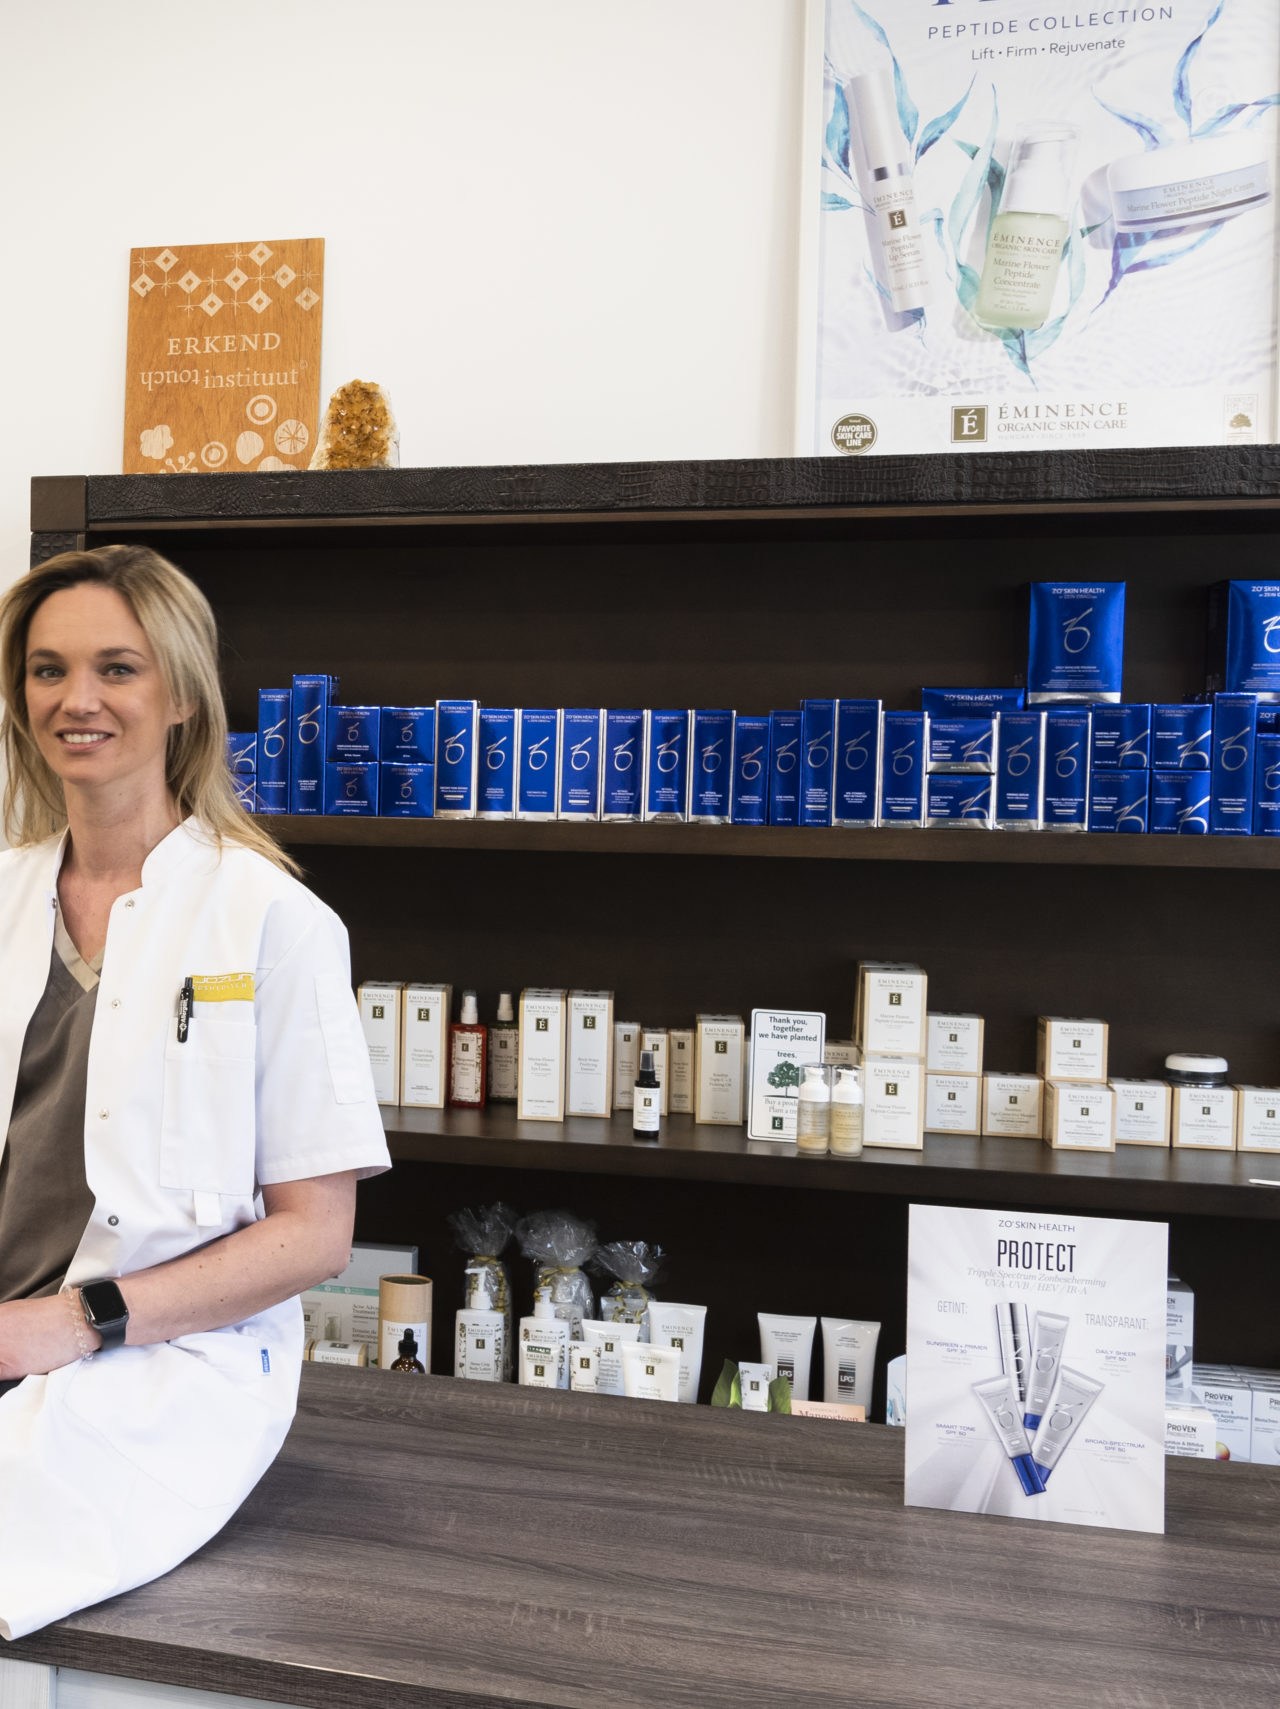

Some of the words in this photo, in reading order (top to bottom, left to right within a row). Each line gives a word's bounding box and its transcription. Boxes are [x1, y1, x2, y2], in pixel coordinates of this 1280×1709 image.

[928, 20, 1018, 39] PEPTIDE
[1028, 6, 1173, 31] COLLECTION
[971, 48, 995, 61] Lift
[1006, 45, 1037, 58] Firm
[1049, 38, 1126, 57] Rejuvenate
[167, 332, 281, 356] ERKEND
[140, 369, 200, 392] touch
[203, 367, 299, 389] instituut
[997, 402, 1128, 420] ÉMINENCE
[837, 424, 871, 433] FAVORITE
[961, 408, 979, 435] É
[997, 421, 1057, 432] ORGANIC
[1060, 420, 1090, 431] SKIN
[1094, 419, 1128, 430] CARE
[836, 432, 853, 440] SKIN
[854, 431, 873, 439] CARE
[846, 439, 862, 447] LINE
[769, 1016, 790, 1024] Thank
[792, 1018, 808, 1026] you,
[773, 1025, 803, 1033] together
[771, 1032, 788, 1040] have
[790, 1034, 817, 1042] planted
[1015, 1221, 1037, 1230] SKIN
[1038, 1223, 1076, 1232] HEALTH
[997, 1239, 1077, 1273] PROTECT
[967, 1267, 998, 1278] Tripple
[998, 1270, 1037, 1281] Spectrum
[1038, 1273, 1107, 1288] Zonbescherming
[984, 1279, 1030, 1290] UVA-UVB
[1036, 1282, 1058, 1293] HEV
[1066, 1284, 1088, 1295] IR-A
[937, 1300, 968, 1314] GETINT:
[1085, 1313, 1149, 1330] TRANSPARANT:
[936, 1423, 958, 1431] SMART
[1084, 1438, 1145, 1448] BROAD-SPECTRUM
